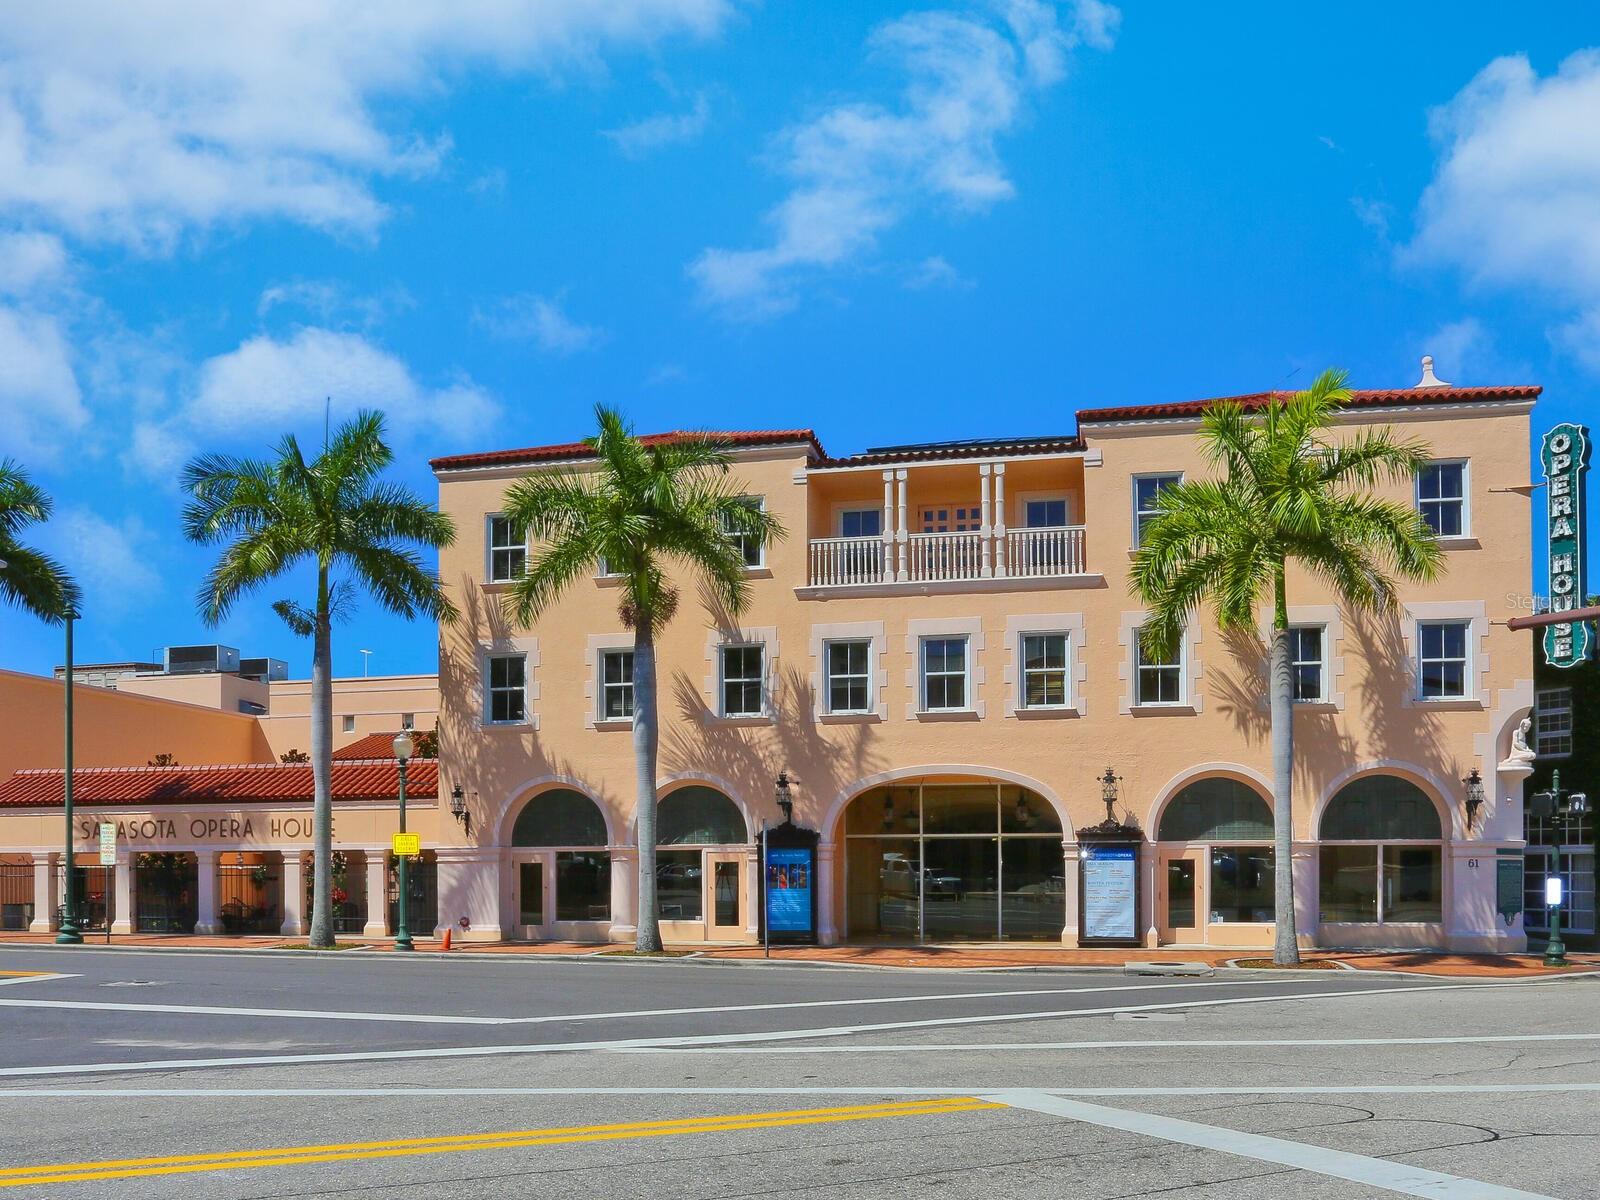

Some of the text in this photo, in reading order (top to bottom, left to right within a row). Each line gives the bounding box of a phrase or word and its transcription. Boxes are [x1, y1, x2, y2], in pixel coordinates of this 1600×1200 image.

[1550, 433, 1573, 539] OPERA
[81, 819, 177, 840] SAASOTA
[190, 818, 254, 839] OPERA
[271, 818, 336, 838] HOUE
[1468, 859, 1480, 868] 61
